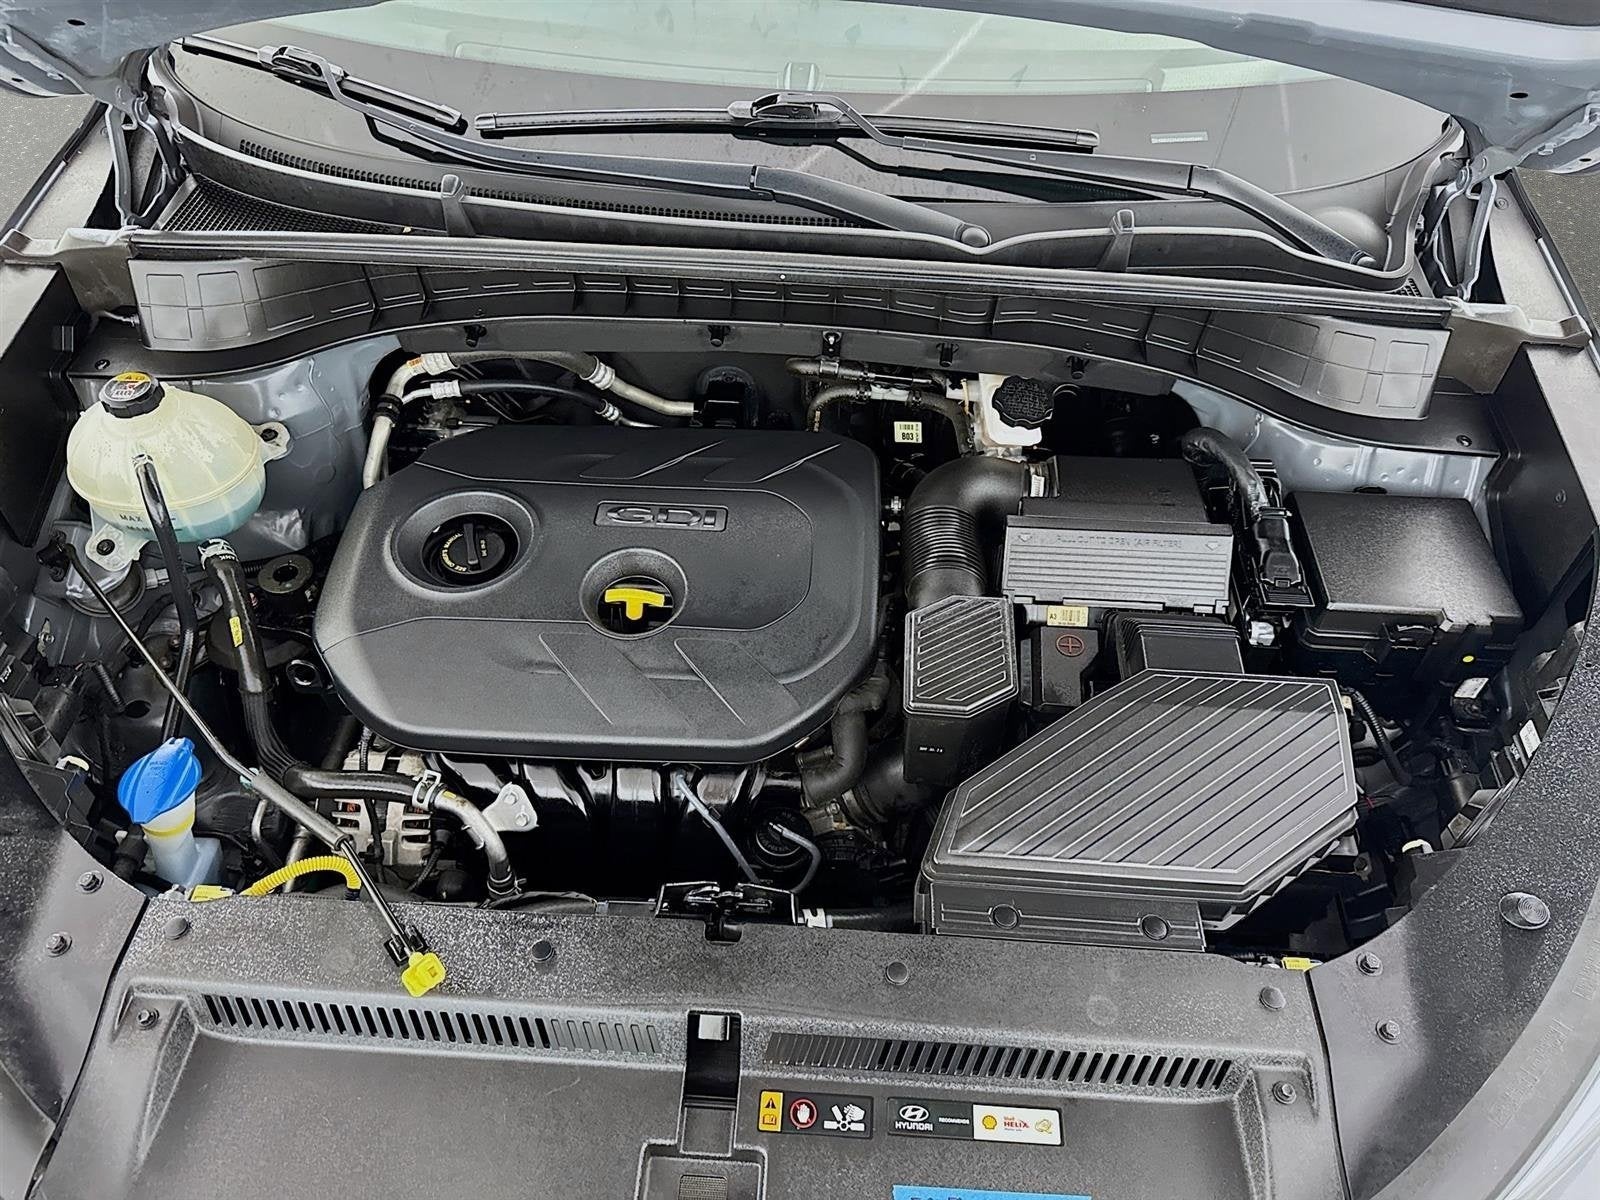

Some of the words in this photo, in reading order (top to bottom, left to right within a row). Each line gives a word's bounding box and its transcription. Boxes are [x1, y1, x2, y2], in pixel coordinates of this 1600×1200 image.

[119, 513, 142, 522] MAX
[606, 506, 717, 528] GDI
[895, 1121, 933, 1131] HYUNDAI
[1003, 1119, 1030, 1129] HELIX
